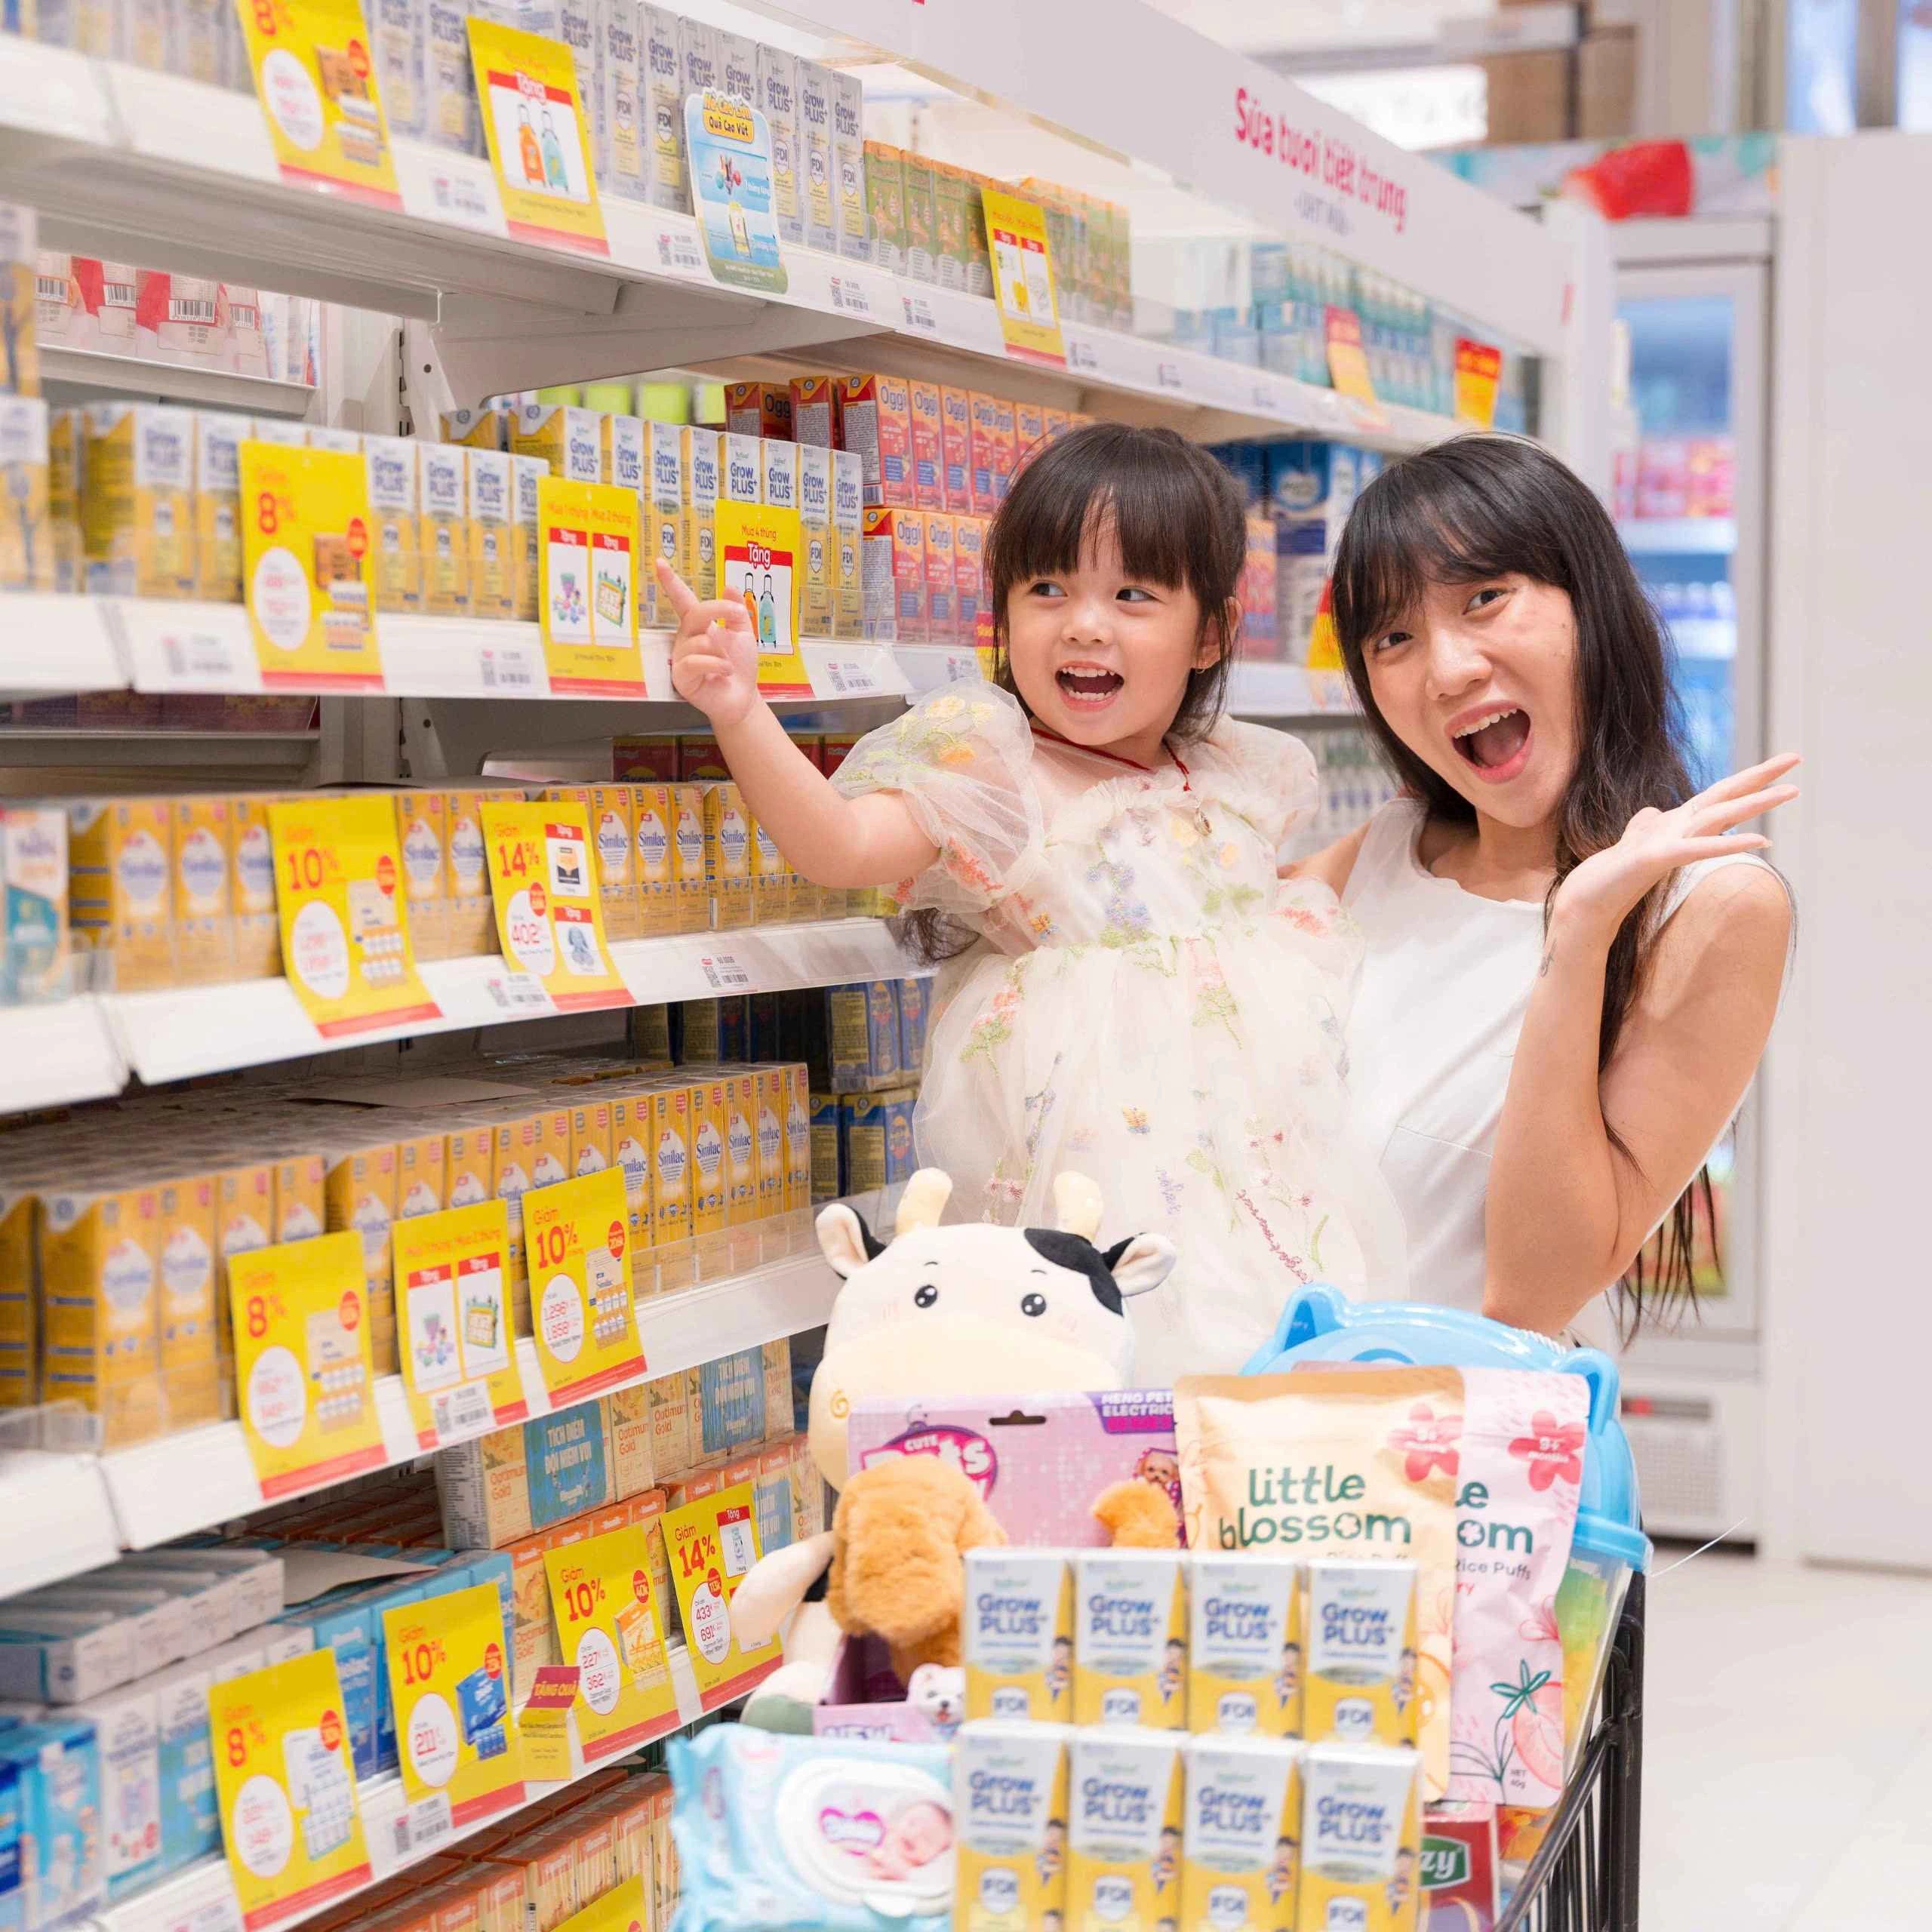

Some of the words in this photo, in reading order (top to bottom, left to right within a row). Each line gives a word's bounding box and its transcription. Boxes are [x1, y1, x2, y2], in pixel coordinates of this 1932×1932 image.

[648, 38, 673, 60] Grow
[766, 76, 790, 97] Grow
[802, 89, 825, 109] Grow
[657, 112, 672, 128] FDI
[835, 102, 856, 122] Grow
[724, 120, 735, 133] Cao
[765, 394, 790, 419] Ogg
[880, 386, 907, 411] Oggi
[914, 391, 938, 416] Oggi
[570, 438, 595, 456] Grow
[655, 450, 676, 468] Grow
[694, 456, 713, 474] Grow
[730, 462, 753, 479] Grow
[769, 467, 790, 484] Grow
[803, 472, 823, 488] Grow
[742, 525, 754, 537] Mua
[760, 527, 777, 541] thùng
[897, 521, 921, 546] Oggi
[748, 542, 771, 569] Tặng
[810, 548, 823, 561] FDI
[638, 832, 666, 847] Similac
[676, 829, 703, 846] Similac
[721, 829, 746, 845] Similac
[287, 846, 340, 891] 10%
[499, 841, 540, 878] 14%
[697, 1141, 721, 1159] Similac
[729, 1134, 752, 1149] Similac
[659, 1149, 685, 1167] Similac
[537, 1220, 578, 1269] 10%
[1102, 1403, 1174, 1417] ELECTRIC
[655, 1419, 672, 1435] Gold
[619, 1439, 636, 1455] Gold
[1248, 1464, 1367, 1507] little
[726, 1509, 740, 1521] Tặng
[675, 1524, 696, 1541] Giảm
[1219, 1507, 1411, 1550] blossom
[678, 1534, 716, 1578] 14%
[1494, 1561, 1532, 1580] Puffs
[565, 1578, 606, 1622] 10%
[977, 1593, 1041, 1614] Grow
[1088, 1595, 1154, 1614] Grow
[1204, 1598, 1270, 1618] Grow
[1321, 1602, 1389, 1624] Grow
[402, 1638, 447, 1686] 10%
[969, 1770, 1035, 1792] Grow
[1083, 1777, 1149, 1800] Grow
[1198, 1786, 1266, 1809] Grow
[1318, 1795, 1386, 1819] Grow
